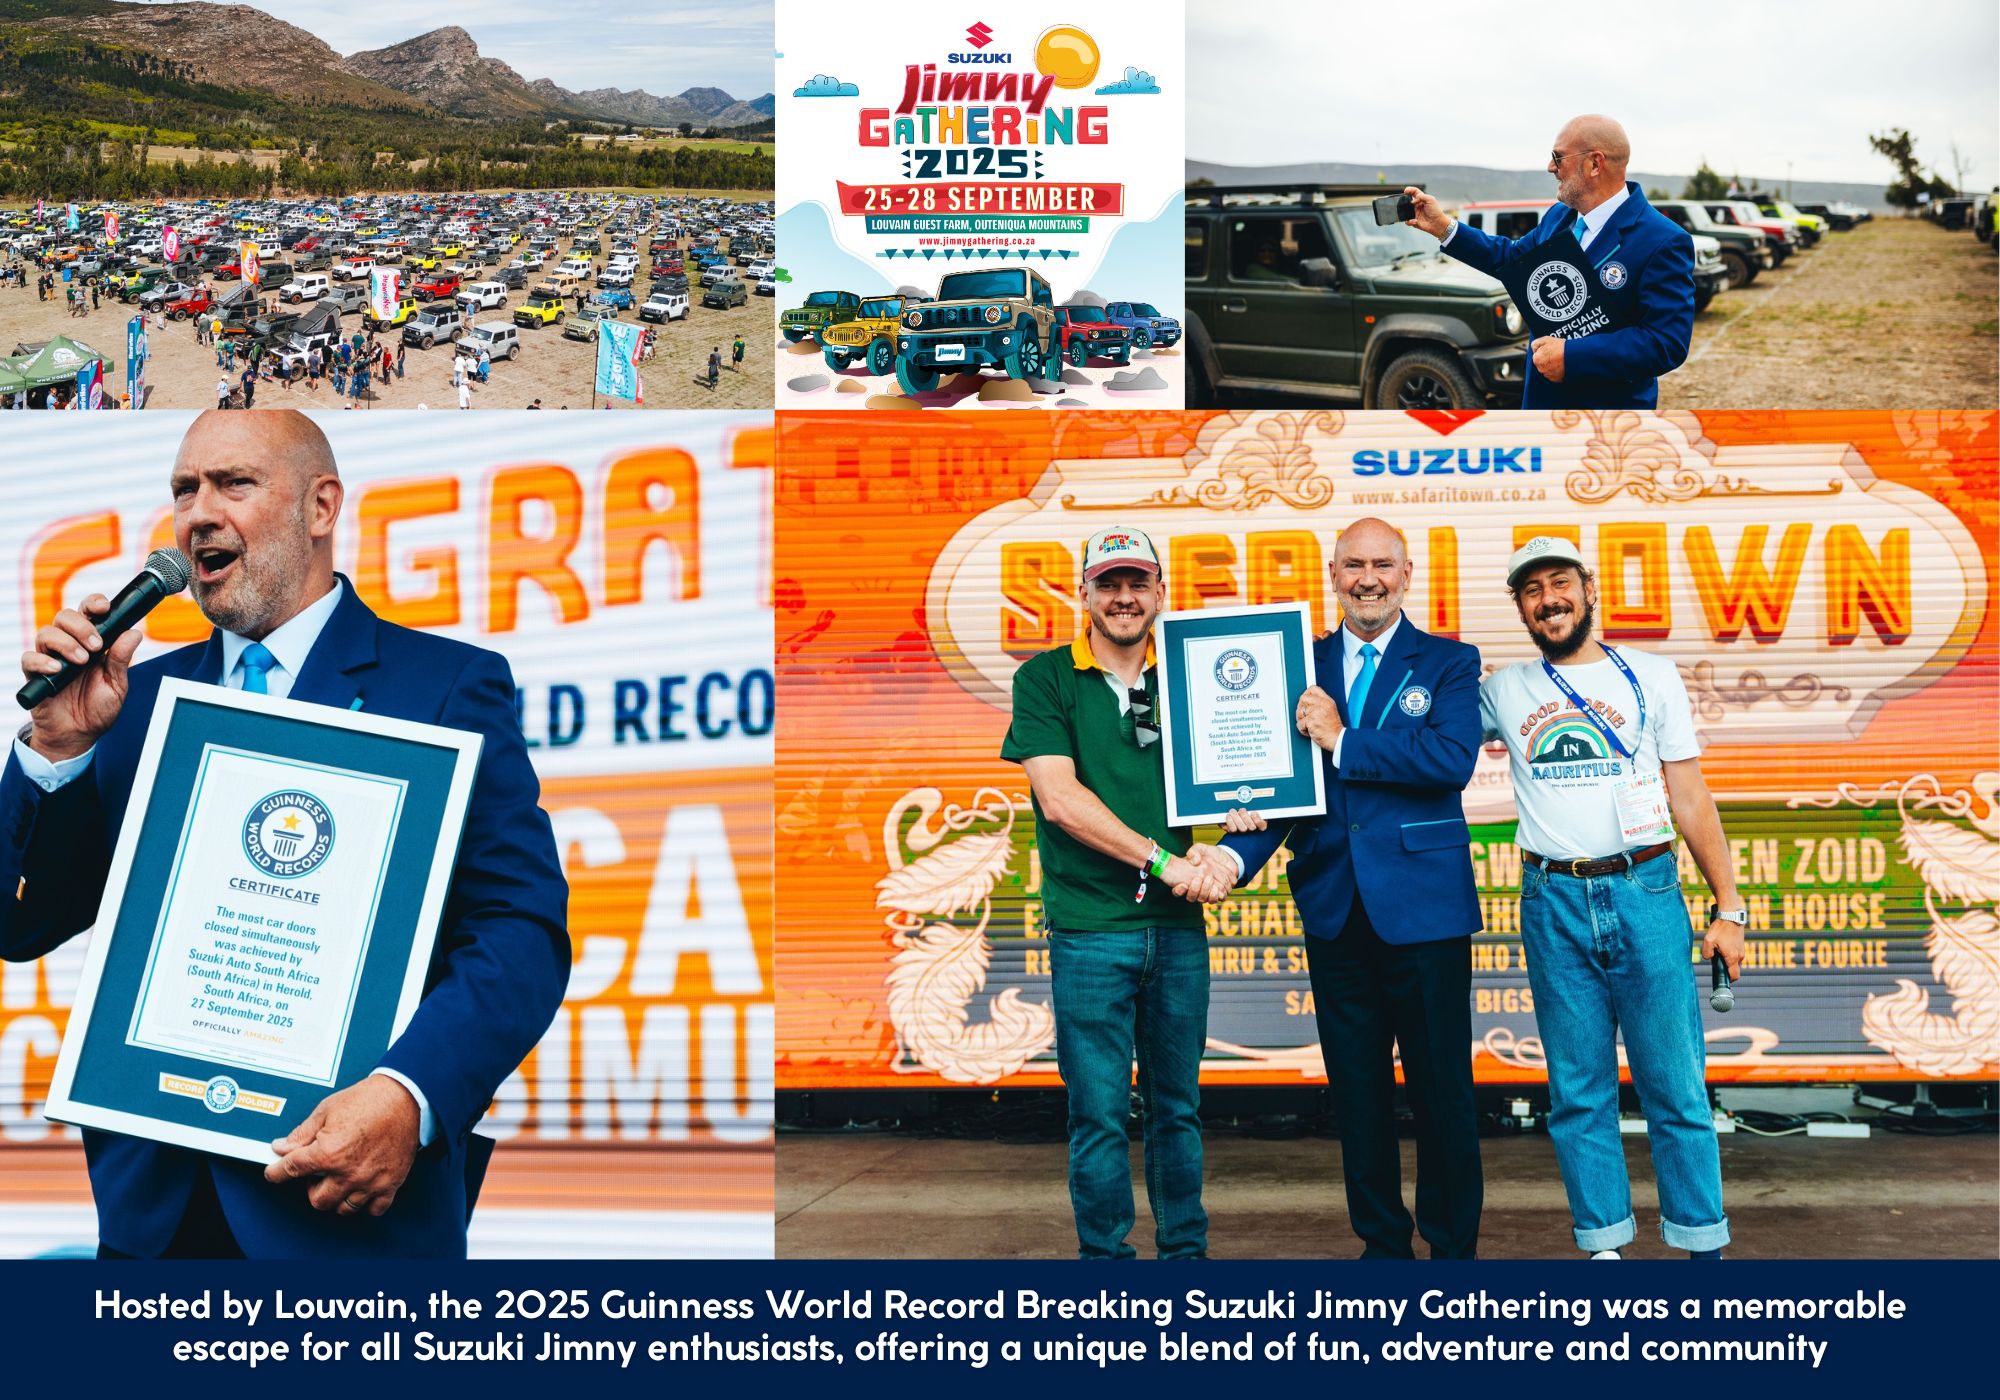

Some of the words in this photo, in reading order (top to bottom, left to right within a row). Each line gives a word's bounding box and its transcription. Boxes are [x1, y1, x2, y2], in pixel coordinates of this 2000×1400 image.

[947, 53, 1012, 64] SUZUKI
[895, 63, 1055, 115] Jimny
[914, 147, 1028, 179] 2025
[864, 187, 936, 211] 25-28
[948, 186, 1096, 211] SEPTEMBER
[871, 219, 911, 230] LOUVAIN
[913, 219, 941, 230] GUEST
[944, 219, 972, 233] FARM,
[974, 218, 1026, 231] OUTENIQUA
[1028, 218, 1083, 230] MOUNTAINS
[918, 236, 1035, 247] www.jimnygathering.co.za
[1531, 265, 1568, 292] GUINNESS
[1533, 298, 1562, 318] WORLD
[1565, 275, 1584, 316] RECORDS
[1550, 305, 1603, 339] OFFICIALLY
[1352, 447, 1543, 477] SUZUKI
[1352, 487, 1547, 505] www.safaritown.co.za
[1218, 650, 1251, 664] GUINNESS
[1216, 668, 1233, 689] WORLD
[1233, 665, 1256, 690] RECORDS
[1215, 692, 1260, 702] CERTIFICATE
[1519, 700, 1560, 737] GOOD
[1587, 709, 1608, 731] SUZUKI
[1563, 743, 1580, 757] IN
[1531, 761, 1623, 781] MAURITIUS
[261, 794, 327, 824] GUINNESS
[247, 822, 271, 868] WORLD
[273, 834, 330, 875] RECORDS
[1793, 838, 1886, 884] ZOID
[228, 877, 321, 905] CERTIFICATE
[216, 906, 236, 919] The
[237, 912, 265, 925] most
[266, 918, 285, 930] car
[286, 921, 317, 936] doors
[1783, 893, 1887, 931] HOUSE
[204, 920, 240, 936] closed
[241, 928, 321, 954] simultaneously
[188, 948, 225, 965] Suzuki
[226, 956, 251, 971] Auto
[254, 962, 285, 978] South
[287, 969, 320, 985] Africa
[214, 939, 237, 952] was
[239, 945, 288, 962] achieved
[289, 953, 303, 967] by
[1803, 941, 1889, 969] FOURIE
[187, 964, 221, 980] (South
[223, 972, 260, 989] Africa)
[262, 980, 273, 991] in
[203, 983, 234, 999] South
[236, 991, 272, 1009] Africa,
[275, 1001, 289, 1011] on
[190, 997, 205, 1009] 27
[207, 1000, 265, 1022] September
[266, 1013, 294, 1028] 2025
[192, 1019, 242, 1036] OFFICIALLY
[167, 1079, 204, 1094] RECORD
[238, 1095, 275, 1110] HOLDER
